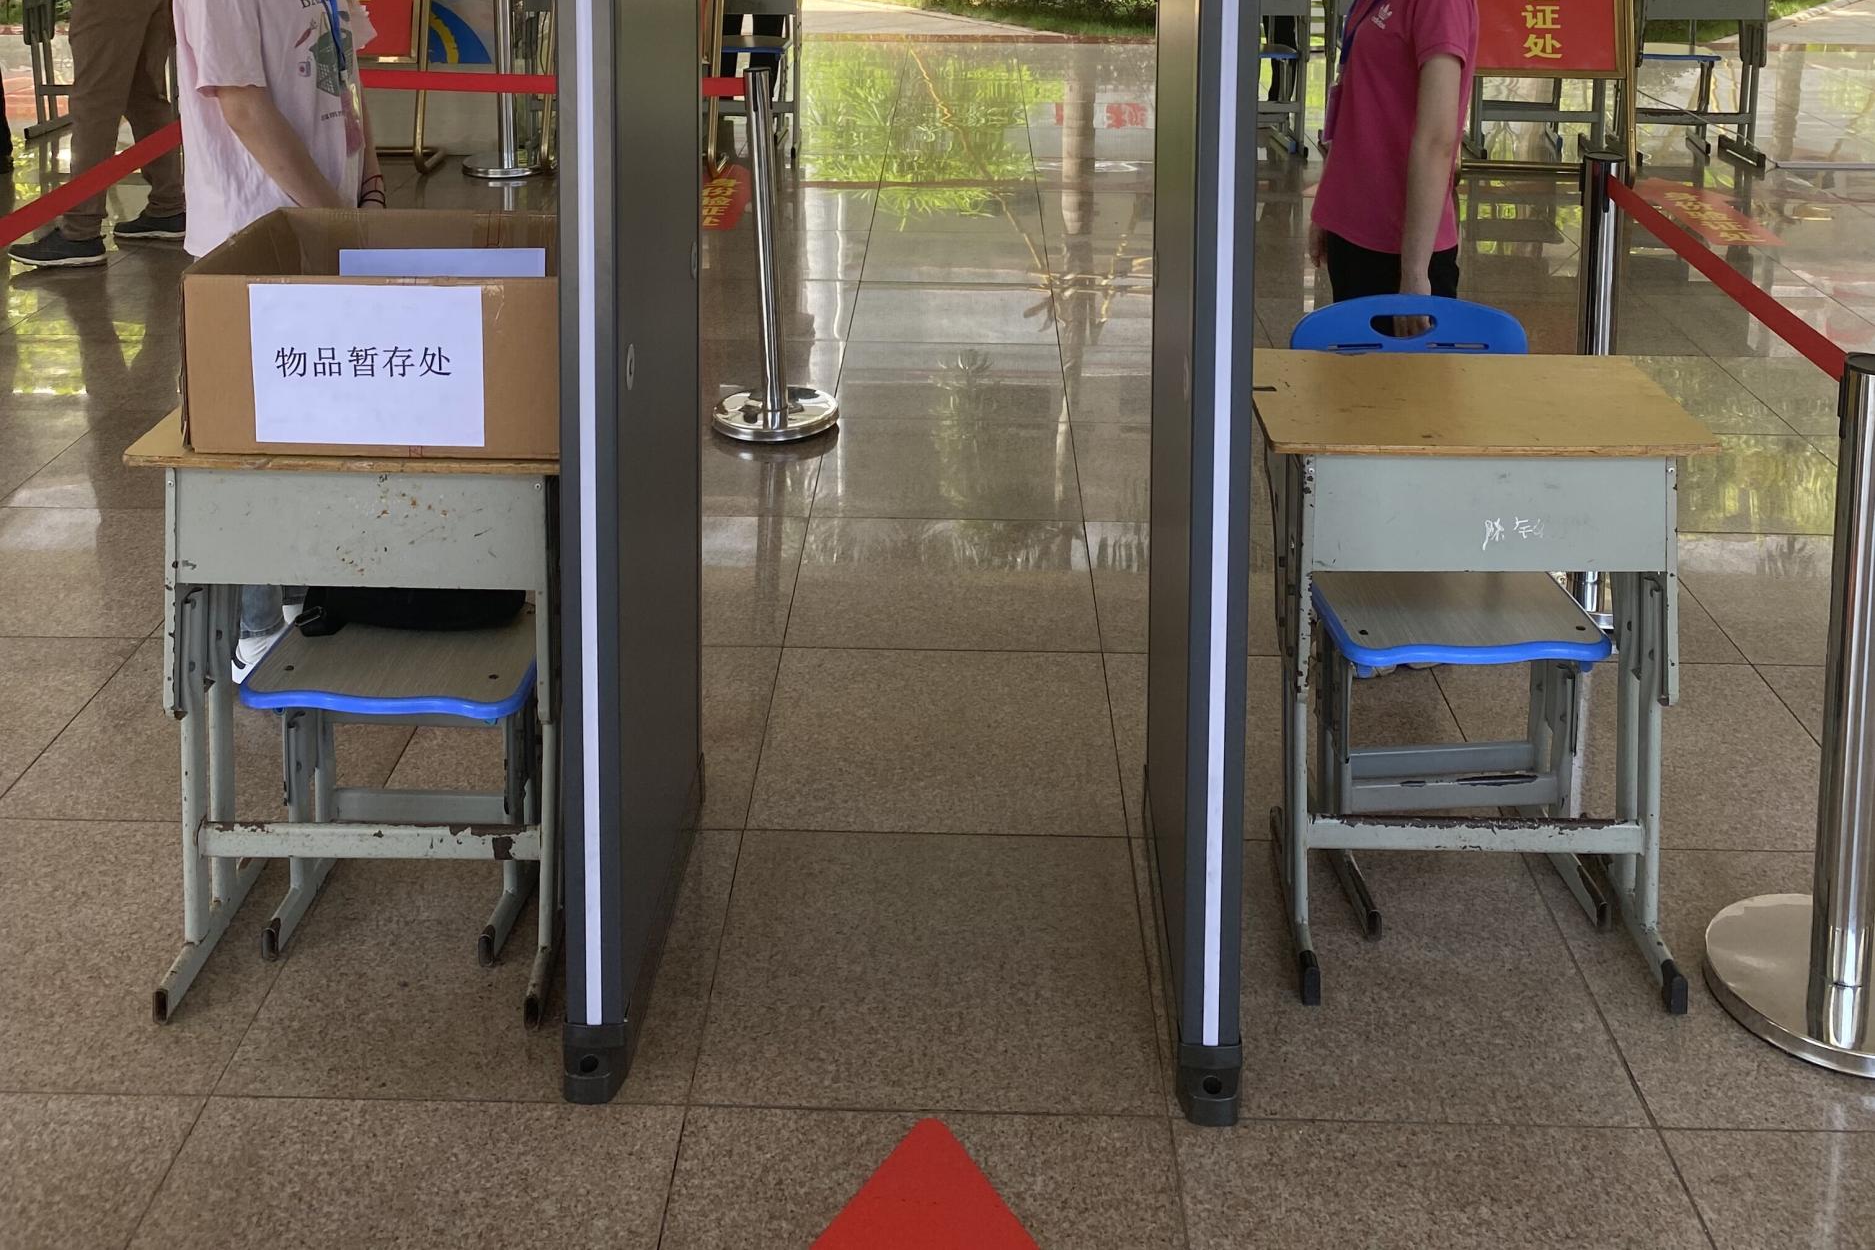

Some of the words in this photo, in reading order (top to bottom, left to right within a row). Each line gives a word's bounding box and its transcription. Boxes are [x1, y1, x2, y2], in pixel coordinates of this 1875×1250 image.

[274, 346, 453, 379] 物品暂存处
